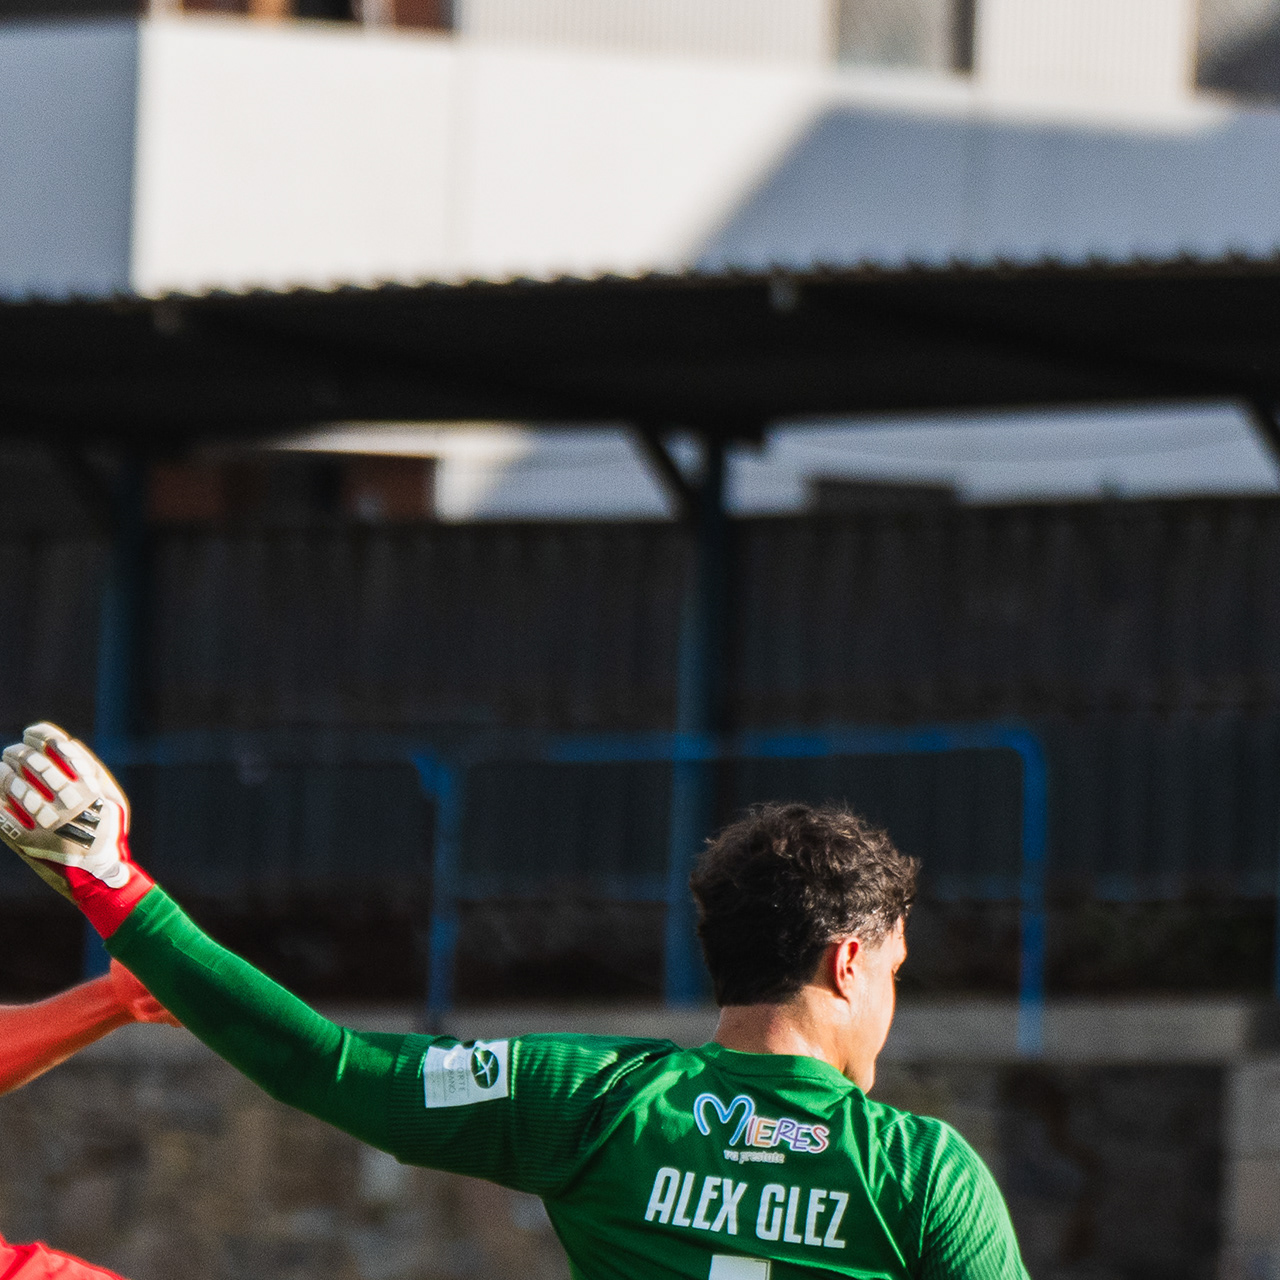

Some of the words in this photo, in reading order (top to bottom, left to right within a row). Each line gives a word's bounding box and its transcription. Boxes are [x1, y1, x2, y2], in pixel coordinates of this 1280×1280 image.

[693, 1093, 830, 1153] MIERES
[644, 1166, 748, 1235] ALEX
[755, 1183, 850, 1249] GLEZ
